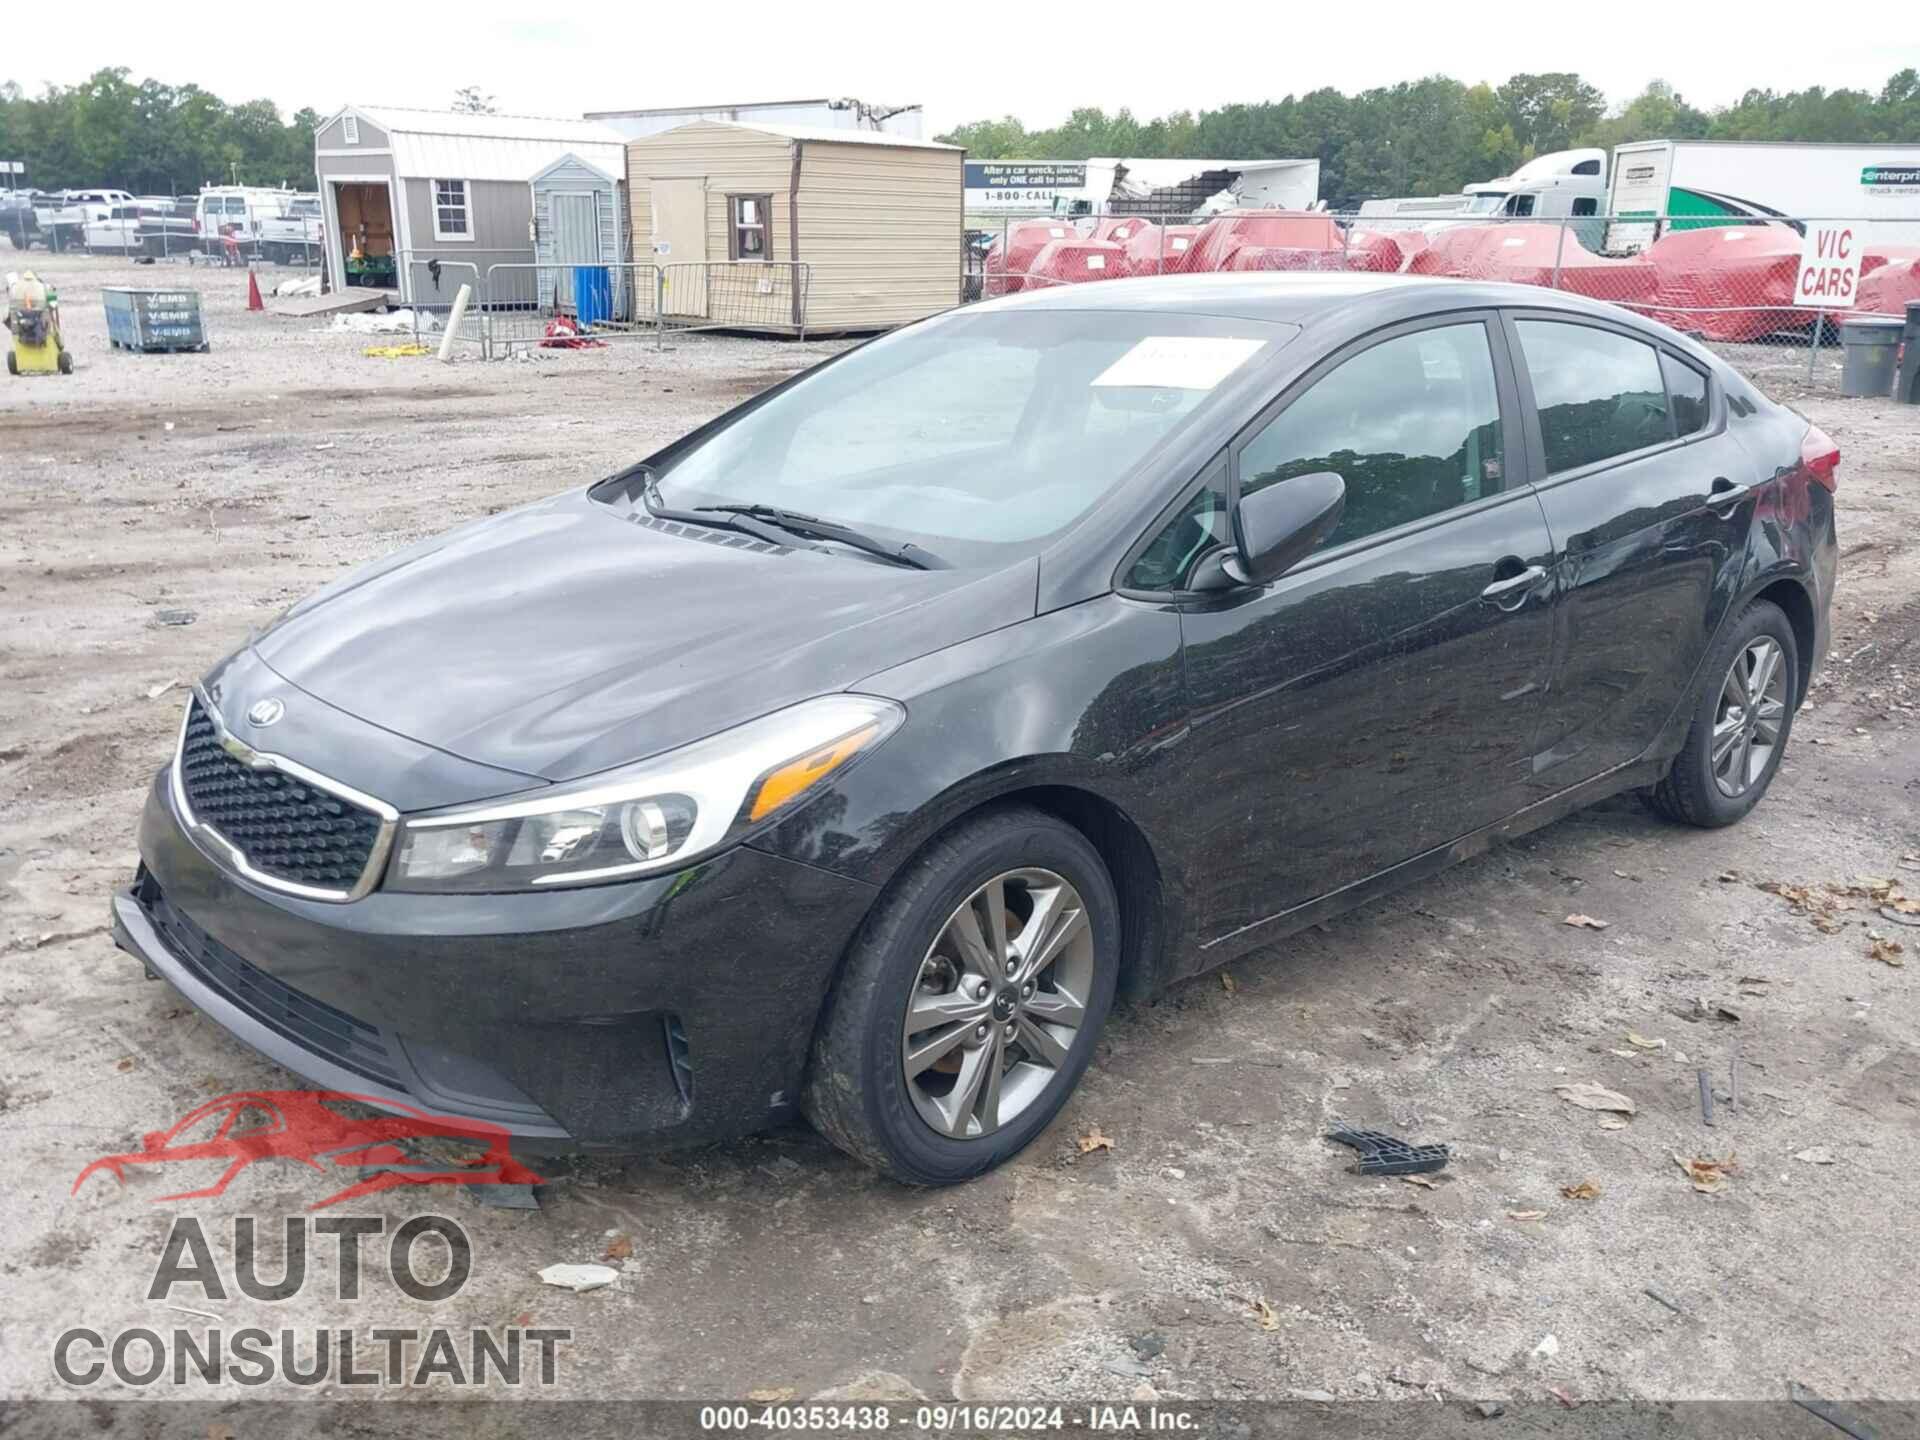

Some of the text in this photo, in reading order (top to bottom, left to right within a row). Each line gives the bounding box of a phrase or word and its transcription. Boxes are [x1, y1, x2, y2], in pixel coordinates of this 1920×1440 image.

[984, 166, 1003, 175] After
[990, 176, 1008, 185] only
[1010, 176, 1027, 184] ONE
[1029, 176, 1044, 184] call
[1046, 176, 1054, 184] to
[1818, 230, 1852, 259] VIC
[1802, 266, 1854, 297] CARS
